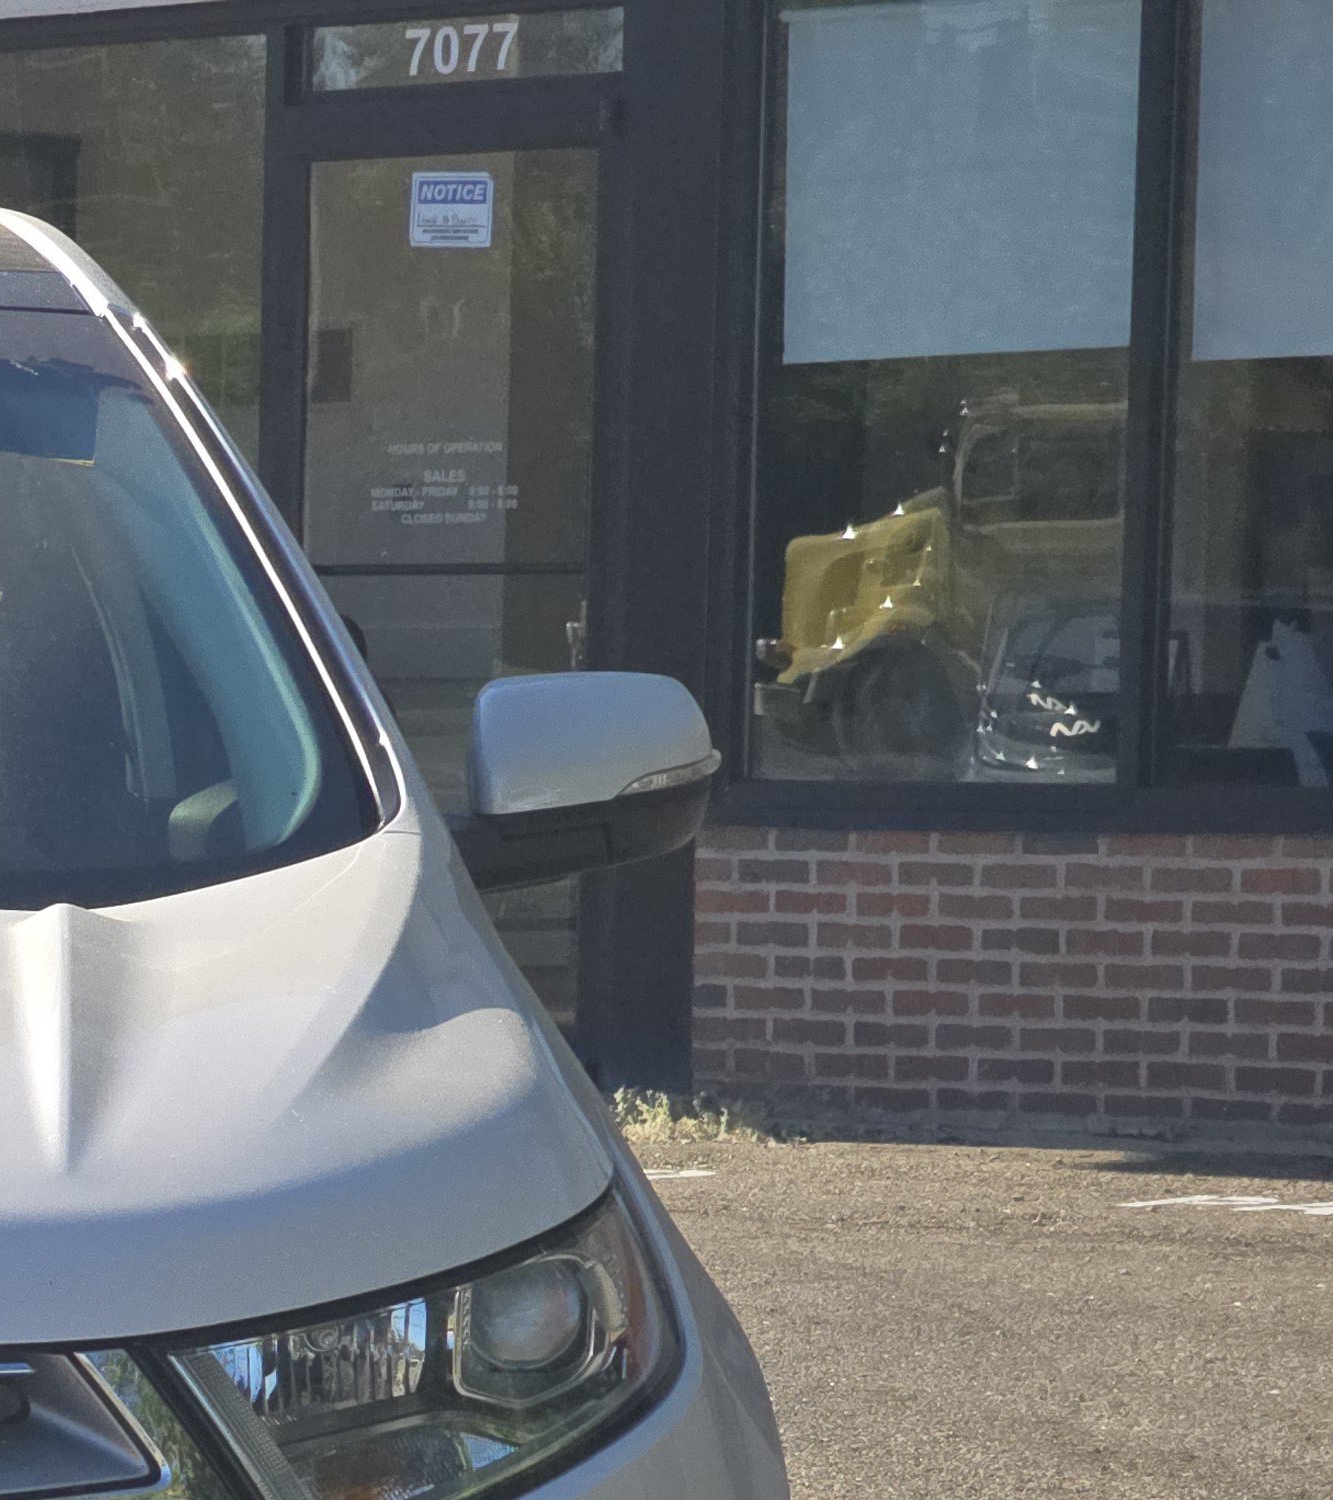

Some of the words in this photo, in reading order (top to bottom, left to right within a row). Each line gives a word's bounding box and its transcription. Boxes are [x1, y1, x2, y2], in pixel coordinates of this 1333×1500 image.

[405, 23, 519, 77] 7077
[420, 183, 486, 201] NOTICE
[423, 469, 466, 483] SALES
[370, 487, 415, 498] MONDAY
[421, 486, 458, 497] FRIDAY
[371, 500, 425, 512] SATURDAY
[401, 513, 443, 524] CLOSED
[445, 512, 487, 524] SUNDAY
